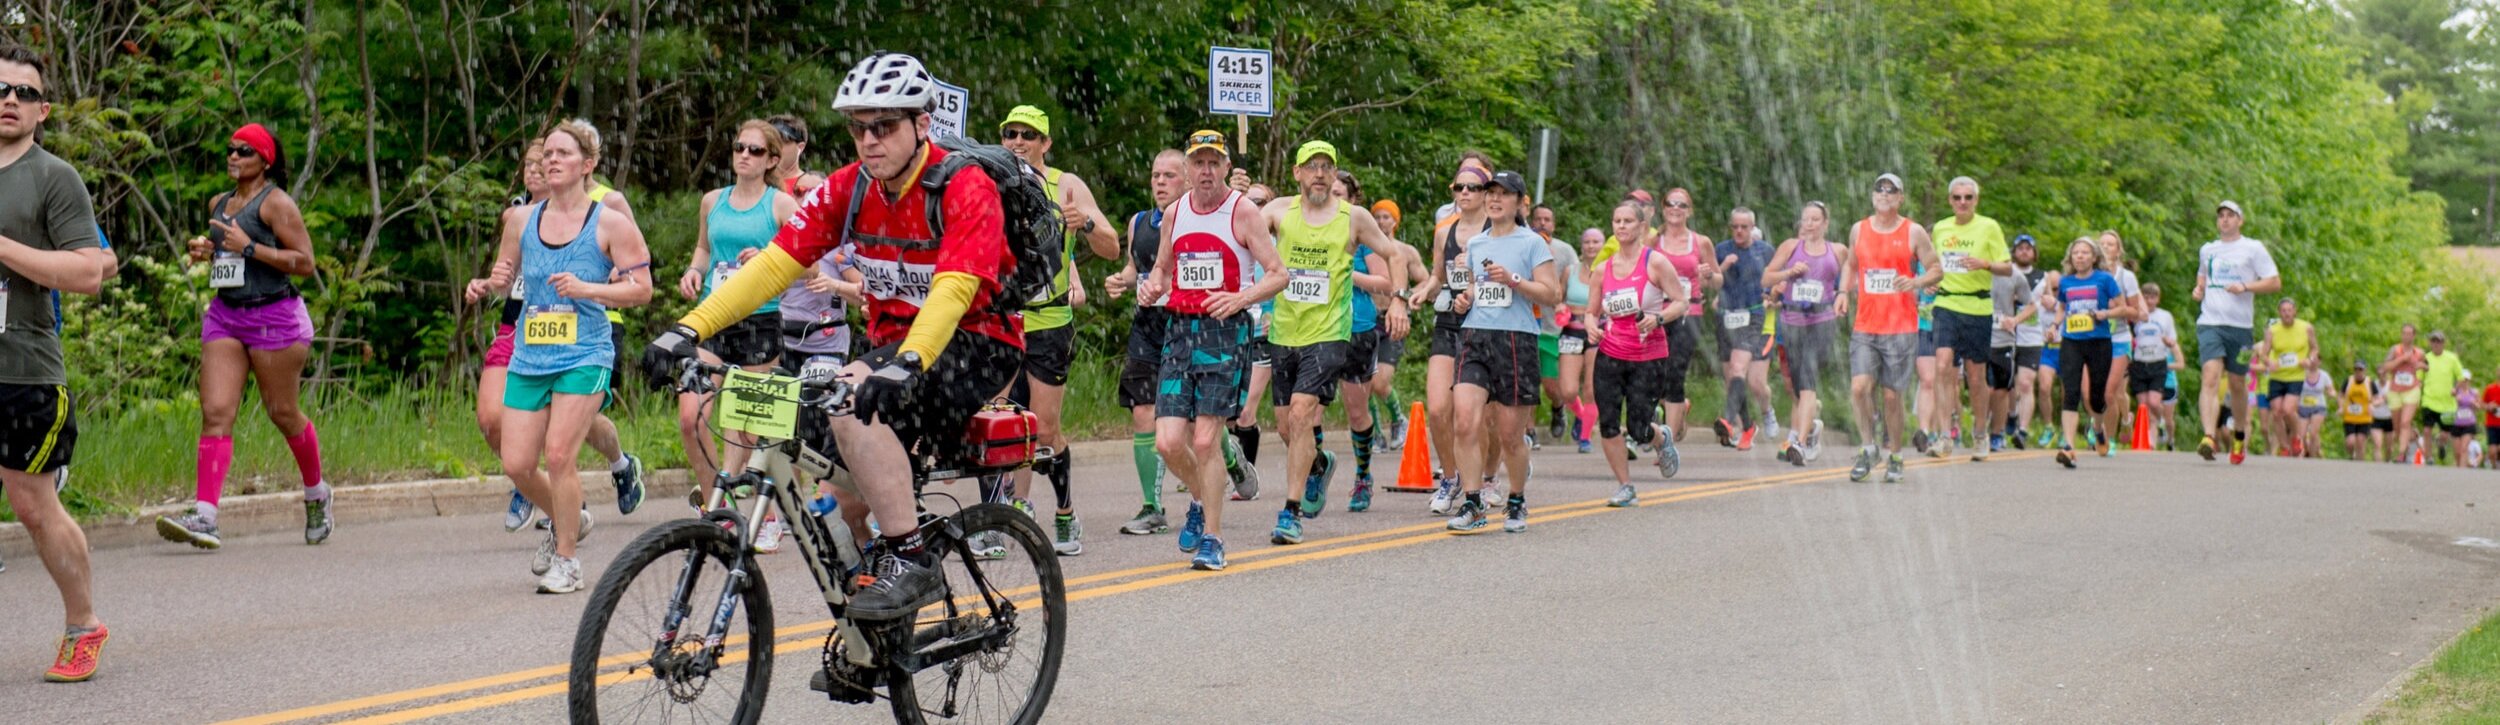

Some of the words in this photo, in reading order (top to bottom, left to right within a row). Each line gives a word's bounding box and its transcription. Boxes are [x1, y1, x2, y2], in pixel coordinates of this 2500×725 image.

[1217, 55, 1264, 75] 4:15
[1219, 81, 1263, 90] SKIRACK
[1220, 90, 1262, 104] PACER
[1291, 245, 1329, 254] SKIRACK
[1289, 257, 1307, 266] PACE
[1308, 259, 1328, 267] TEAM
[897, 267, 935, 286] MOU
[1182, 266, 1215, 282] 3501
[1291, 281, 1322, 297] 1032
[1870, 278, 1892, 289] 2172
[1478, 287, 1506, 300] 2504
[1607, 297, 1633, 313] 2608
[528, 321, 568, 338] 6364
[731, 378, 788, 400] OFFICIAL
[735, 400, 774, 416] BIKER
